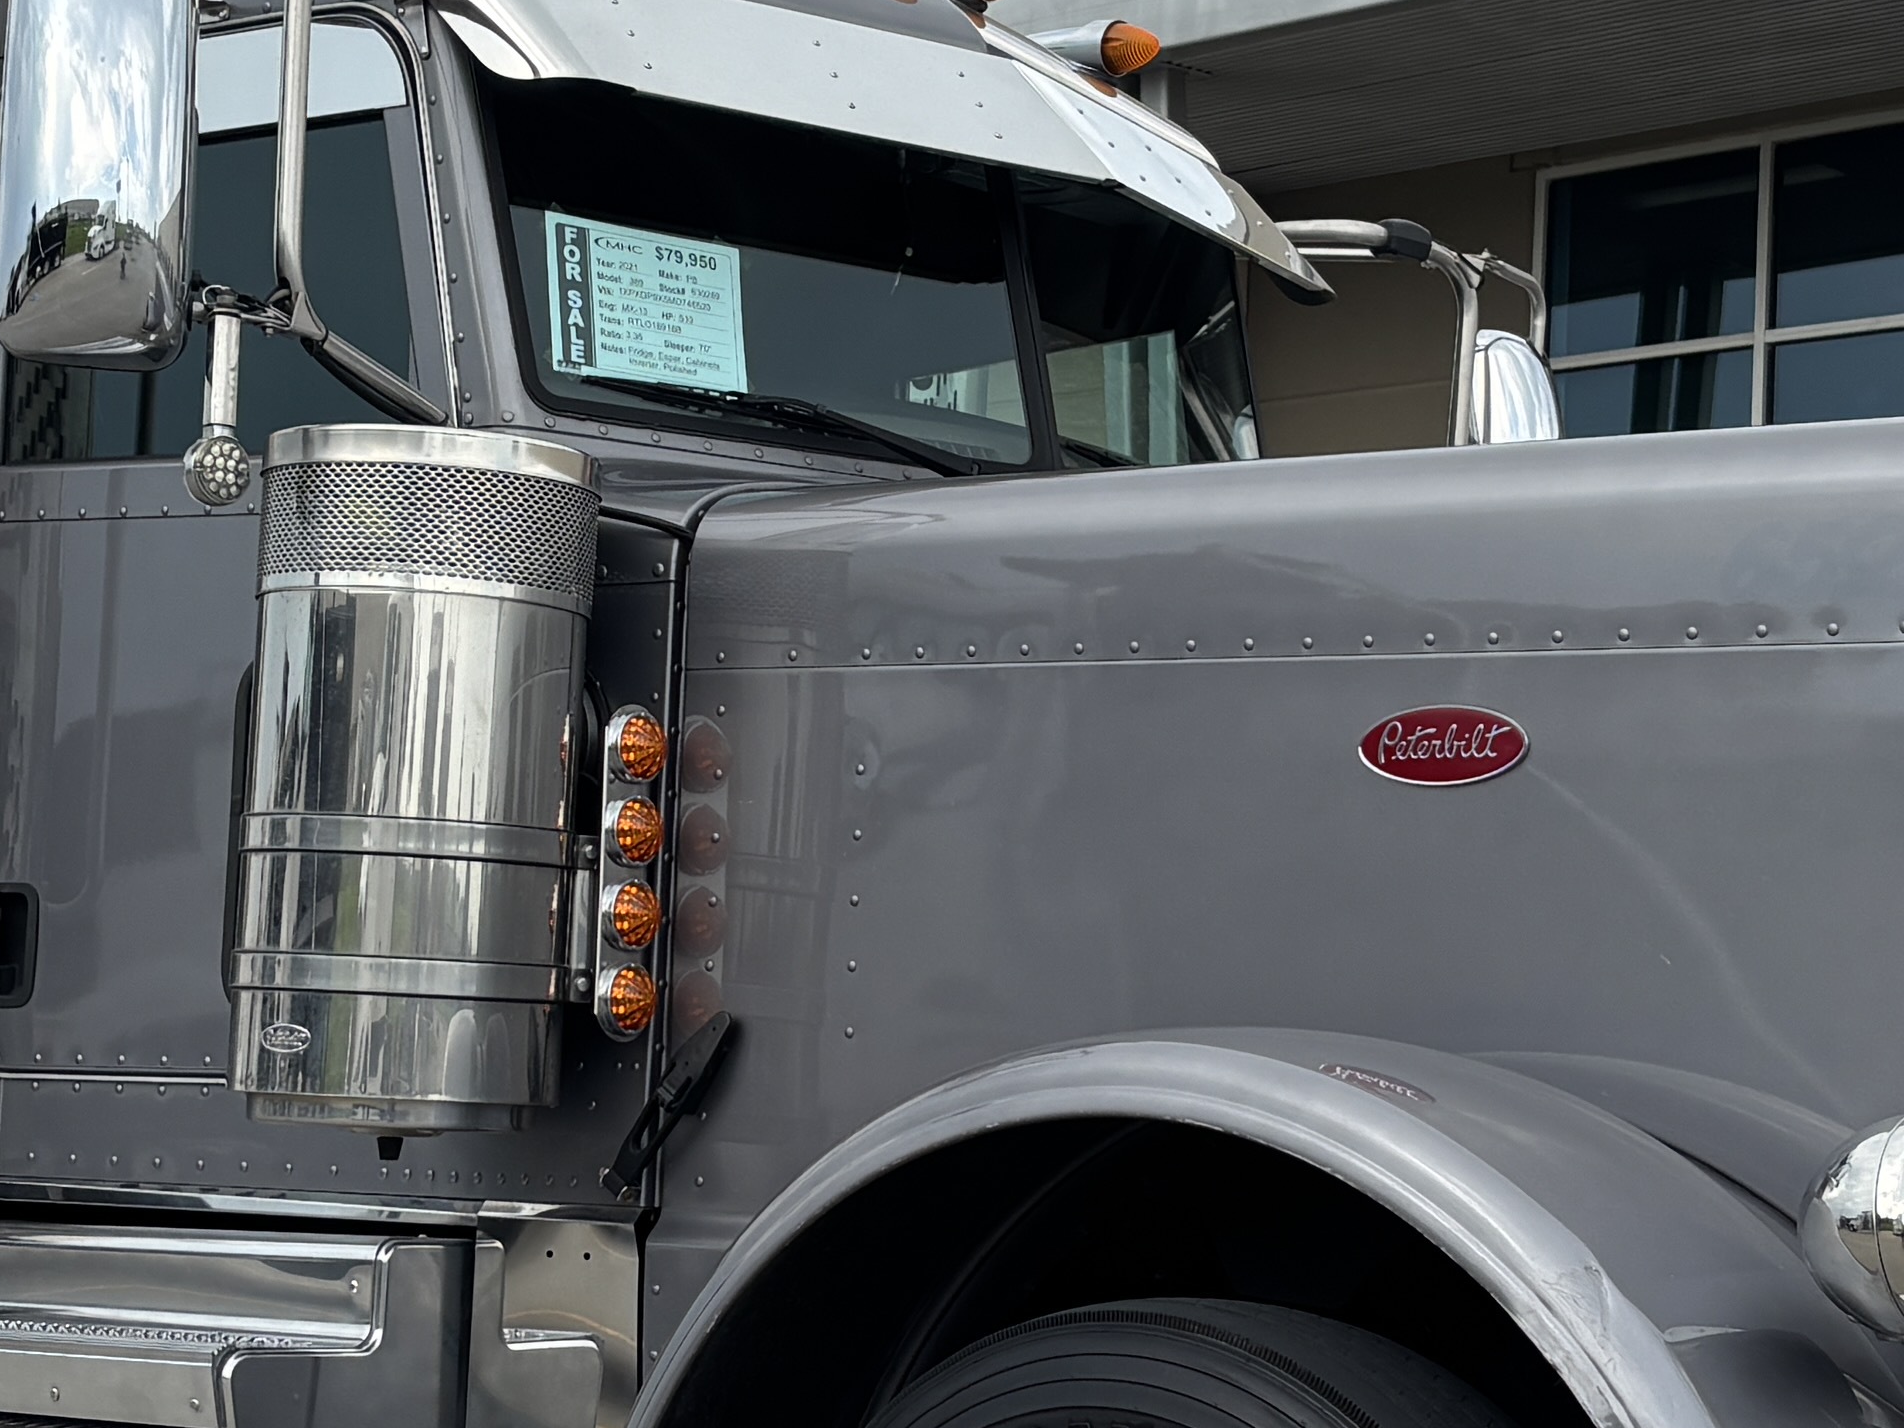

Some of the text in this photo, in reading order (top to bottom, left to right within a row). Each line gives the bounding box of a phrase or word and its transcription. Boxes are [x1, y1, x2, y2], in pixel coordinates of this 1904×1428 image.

[655, 245, 716, 270] $79,950
[563, 226, 586, 363] FOR SALE
[1377, 720, 1513, 765] Peterbilt
